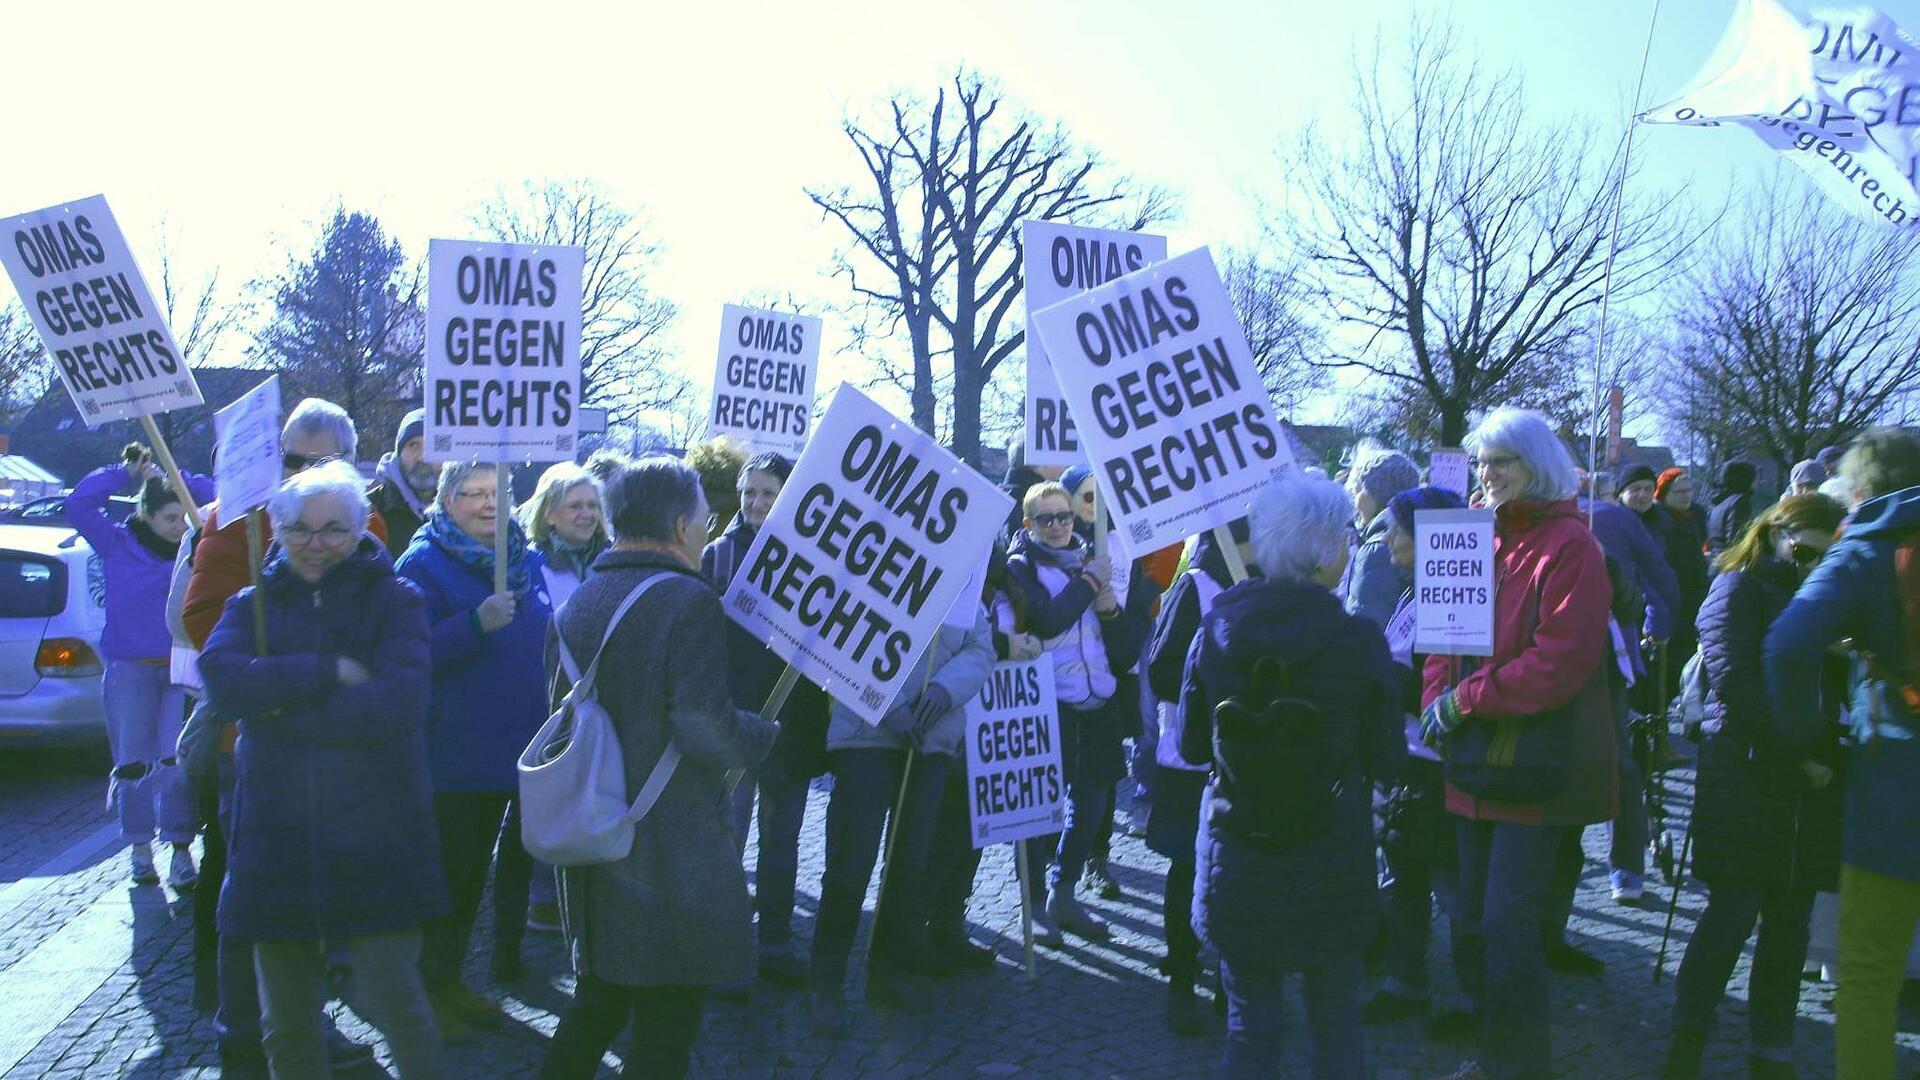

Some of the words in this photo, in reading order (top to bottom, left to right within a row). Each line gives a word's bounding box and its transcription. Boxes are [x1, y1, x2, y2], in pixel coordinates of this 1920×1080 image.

[15, 215, 105, 278] OMAS
[1051, 236, 1143, 289] OMAS
[36, 272, 143, 336] GEGEN
[457, 255, 557, 307] OMAS
[446, 317, 565, 367] GEGEN
[739, 316, 804, 354] OMAS
[1076, 276, 1200, 367] OMAS
[56, 330, 178, 393] RECHTS
[727, 355, 806, 395] GEGEN
[434, 379, 572, 427] RECHTS
[1091, 337, 1242, 439] GEGEN
[715, 394, 806, 435] RECHTS
[1035, 397, 1078, 452] RE
[841, 424, 968, 545] OMAS
[1104, 404, 1277, 516] RECHTS
[794, 482, 943, 620] GEGEN
[1430, 532, 1478, 550] OMAS
[1425, 560, 1482, 577] GEGEN
[746, 534, 912, 683] RECHTS
[1421, 587, 1487, 604] RECHTS
[980, 666, 1040, 711] OMAS
[977, 715, 1050, 763] GEGEN
[975, 764, 1059, 816] RECHTS
